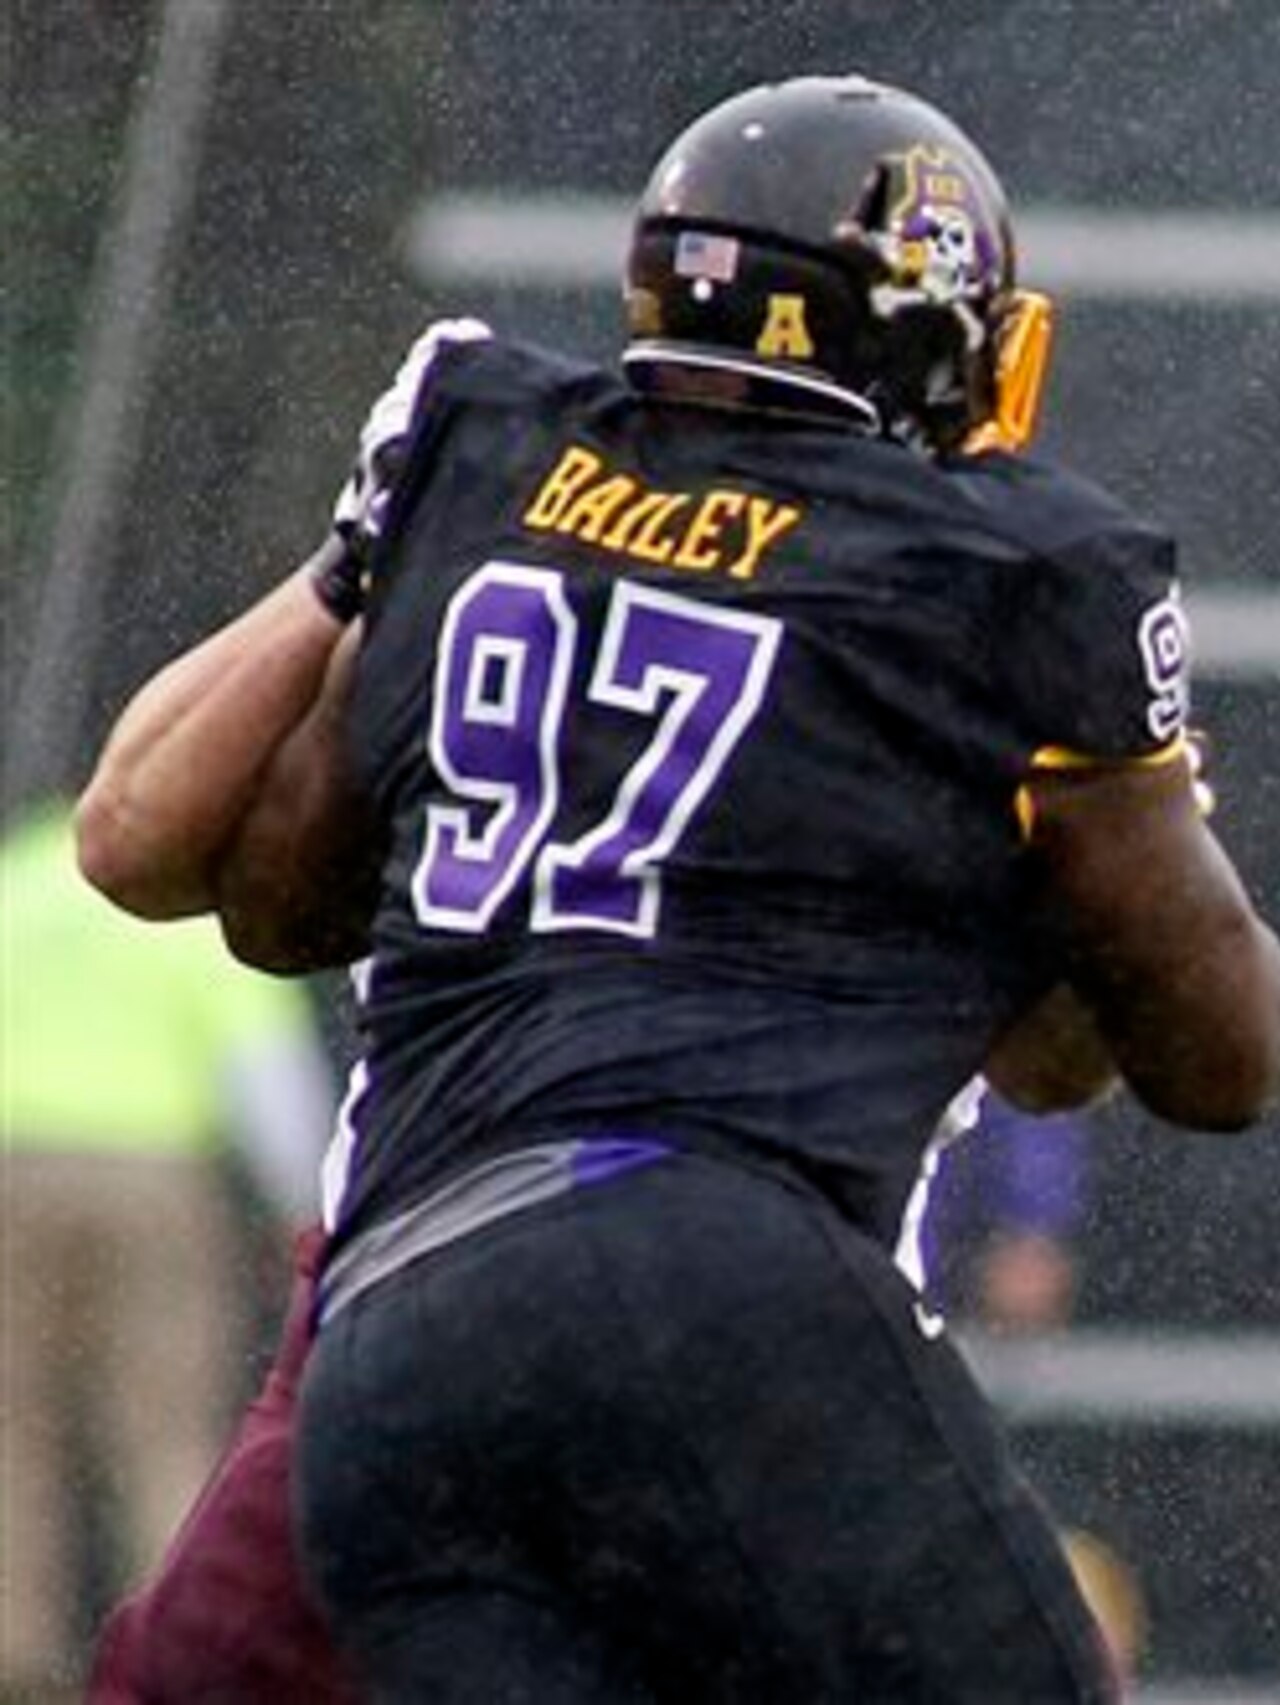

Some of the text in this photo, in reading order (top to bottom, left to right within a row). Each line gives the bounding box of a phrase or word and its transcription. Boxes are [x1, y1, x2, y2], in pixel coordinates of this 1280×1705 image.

[756, 294, 814, 358] A
[524, 447, 800, 578] BAILEY
[412, 561, 784, 937] 97
